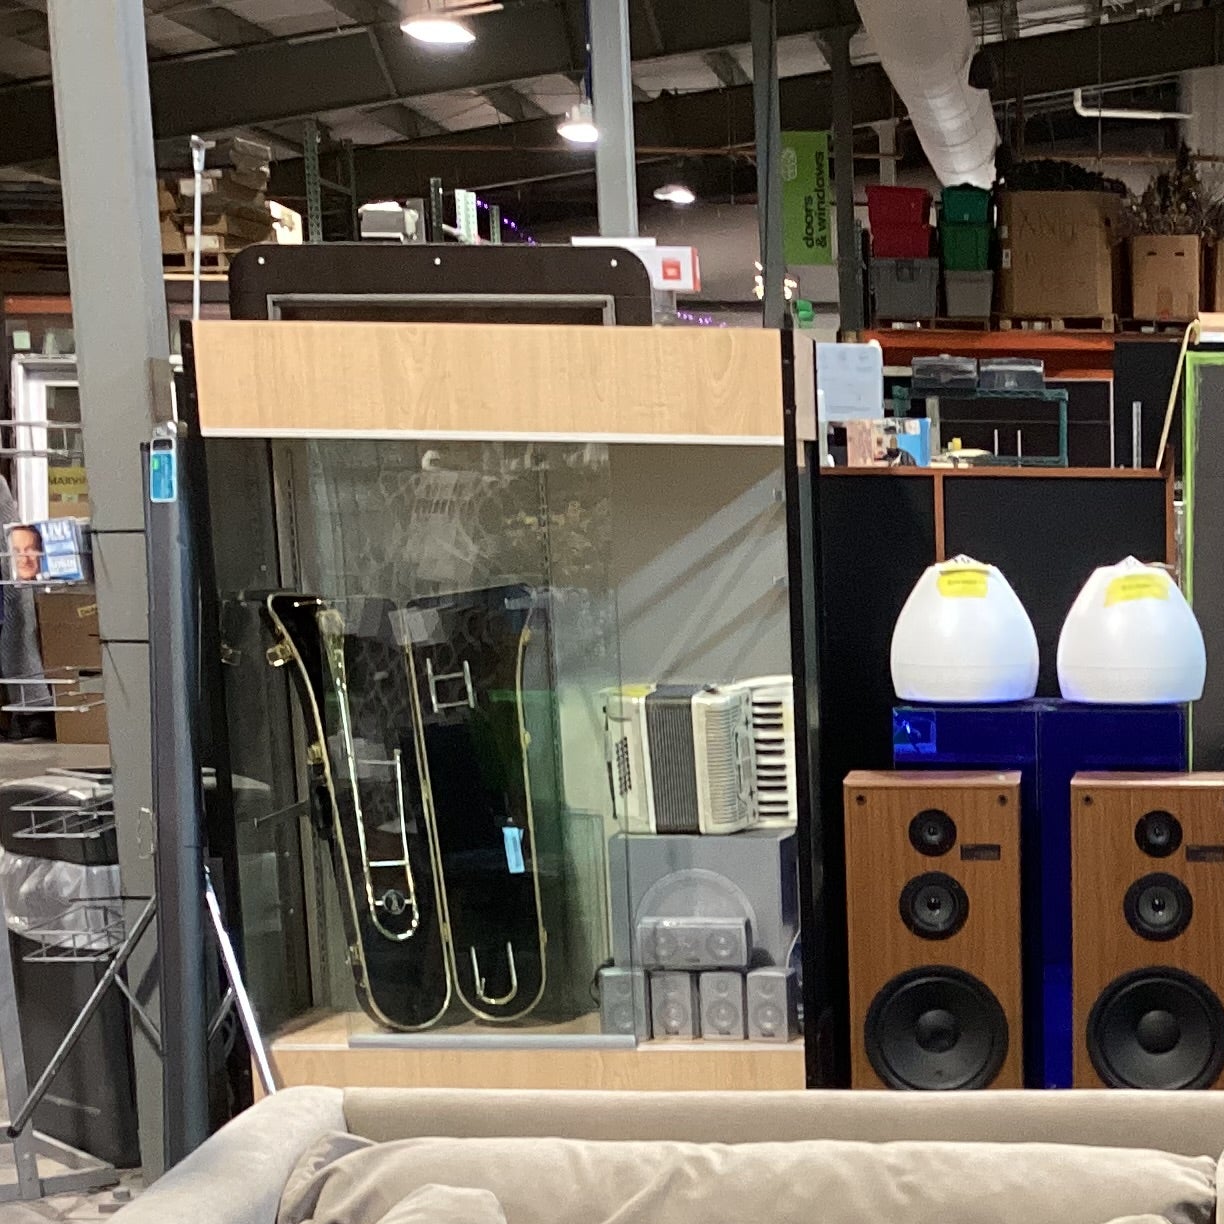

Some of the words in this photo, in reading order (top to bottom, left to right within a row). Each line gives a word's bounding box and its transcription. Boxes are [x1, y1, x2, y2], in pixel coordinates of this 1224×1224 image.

[814, 150, 826, 232] windows
[803, 195, 814, 248] doors
[815, 235, 827, 248] &
